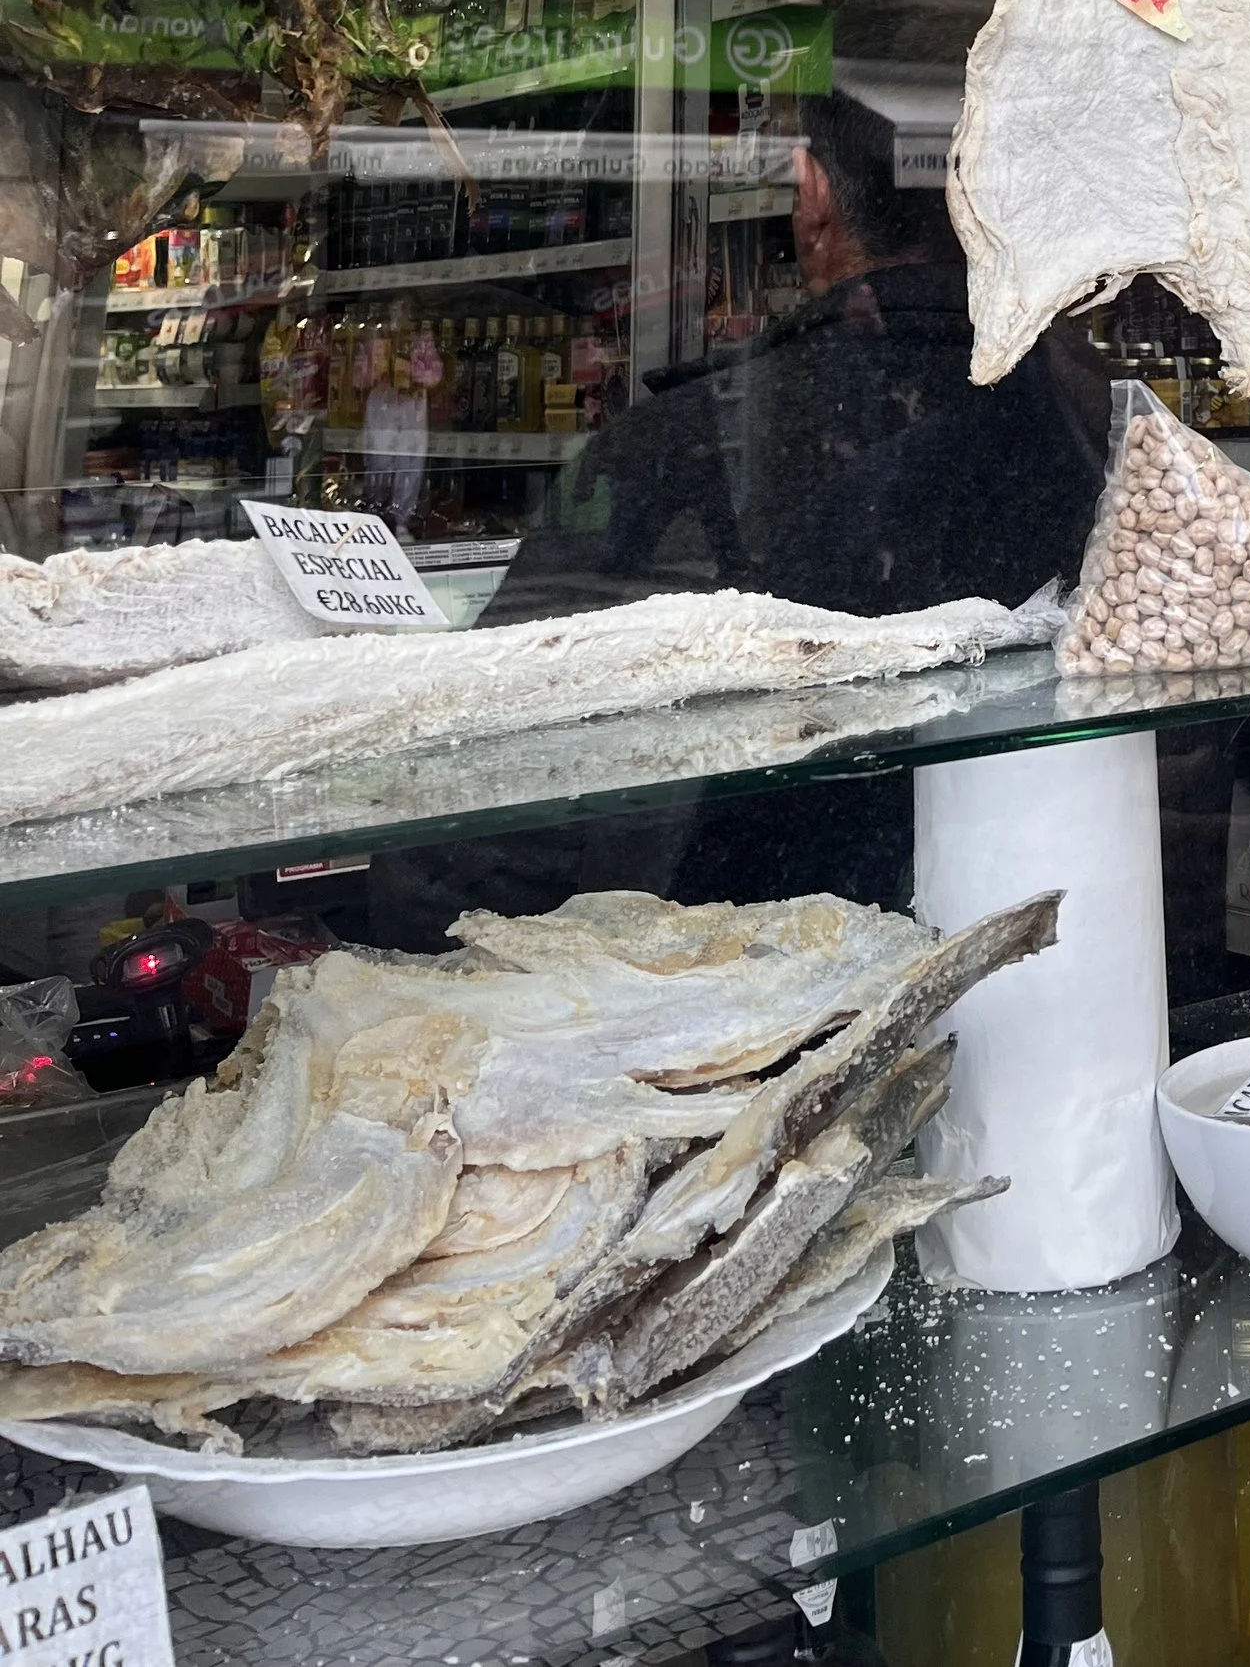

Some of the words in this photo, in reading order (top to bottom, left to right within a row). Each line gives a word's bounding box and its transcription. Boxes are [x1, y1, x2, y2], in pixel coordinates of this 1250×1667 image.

[261, 514, 387, 545] BACALHAU
[291, 552, 402, 581] ESPECIAL
[317, 589, 426, 616] €28.60KG
